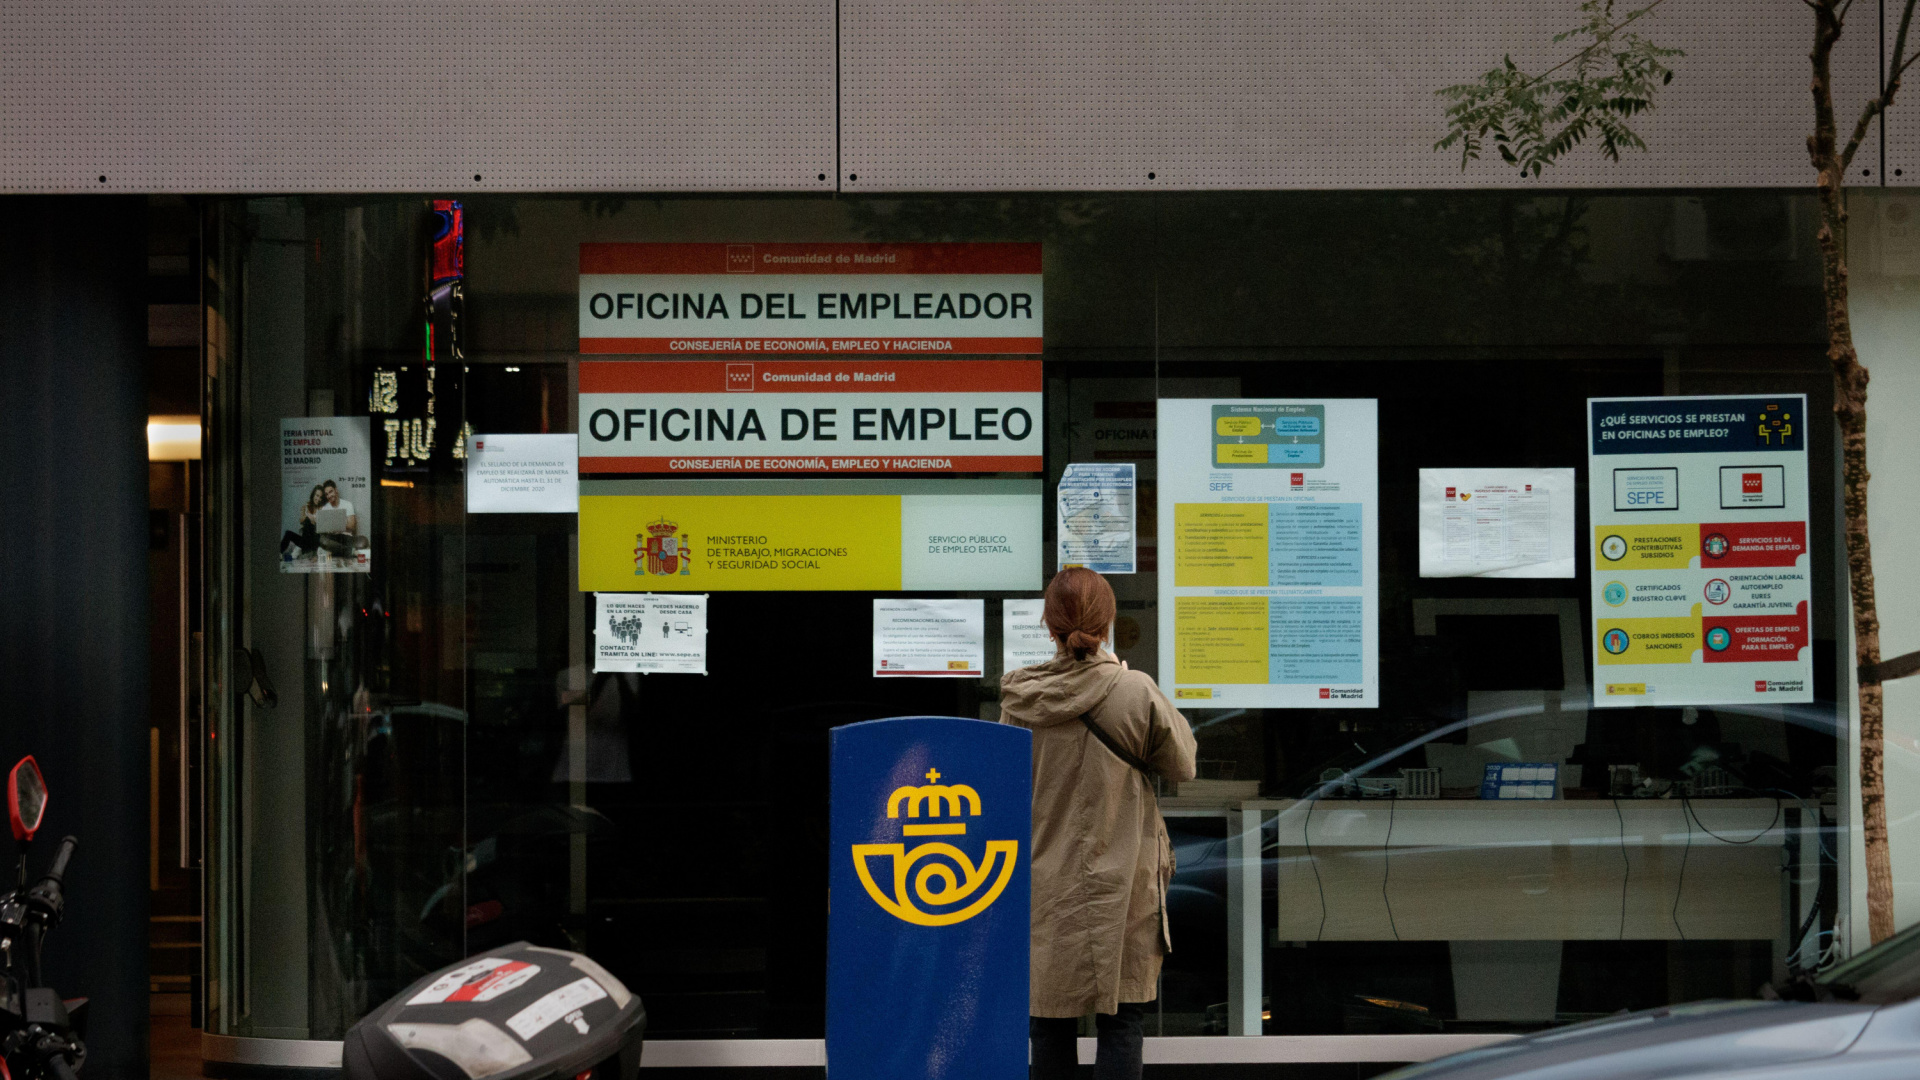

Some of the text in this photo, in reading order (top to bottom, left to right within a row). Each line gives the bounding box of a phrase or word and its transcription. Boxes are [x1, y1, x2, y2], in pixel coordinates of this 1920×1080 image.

[763, 253, 896, 264] Comunidad de Madrid
[589, 292, 1032, 320] OFICINA DEL EMPLEADOR
[670, 339, 952, 352] CONSEJERÍA DE ECONOMÍA, EMPLEO Y HACIENDA
[762, 372, 896, 382] Comunidad de Madrid
[589, 407, 1032, 442] OFICINA DE EMPLEO
[1600, 413, 1745, 427] ¿QUÉ SERVICIOS SE PRESTAN
[1095, 429, 1148, 440] OFICINA
[1602, 428, 1729, 440] EN OFICINAS DE EMPLEO?
[670, 457, 952, 471] CONSEJERÍA DE ECONOMÍA, EMPLEO Y HACIENDA
[1209, 483, 1233, 491] SEPE
[1628, 491, 1664, 505] SEPE
[707, 536, 767, 545] MINISTERIO
[928, 533, 1006, 544] SERVICIO PÚBLICO
[707, 548, 848, 559] DE TRABAJO, MIGRACIONES
[943, 546, 976, 554] EMPLEO
[979, 545, 1012, 553] ESTATAL
[707, 560, 820, 570] Y SEGURIDAD SOCIAL
